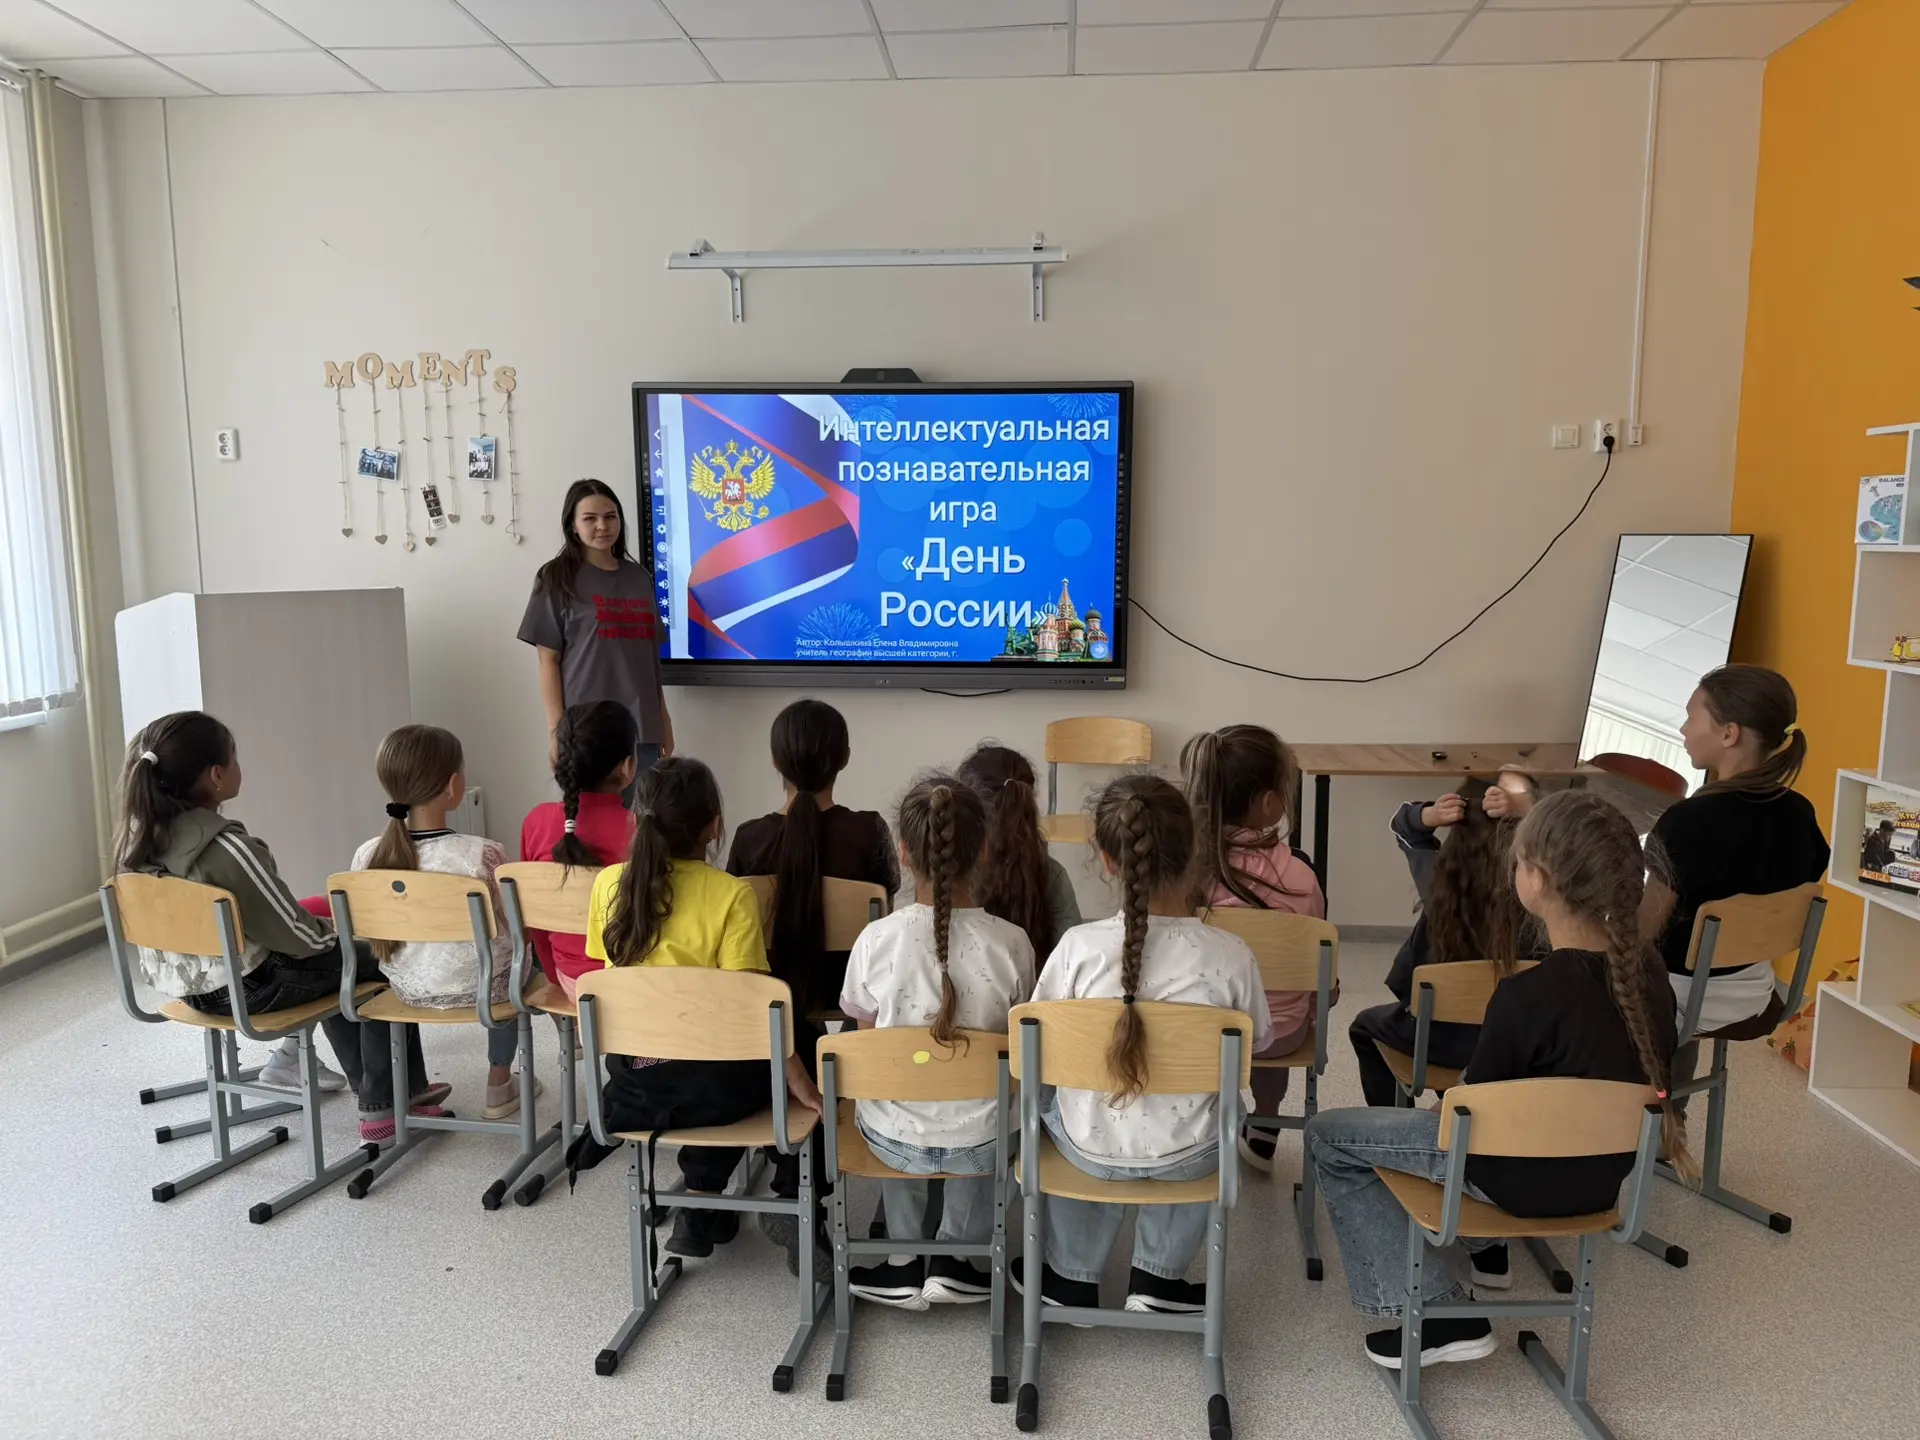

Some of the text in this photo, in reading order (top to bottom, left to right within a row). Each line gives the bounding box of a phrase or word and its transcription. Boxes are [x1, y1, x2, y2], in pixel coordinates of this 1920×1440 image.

[323, 349, 517, 393] MOMENTS
[818, 413, 1110, 448] Интеллектуальная
[838, 460, 1090, 482] познавательная
[929, 501, 998, 528] игра
[901, 537, 1026, 581] «День
[880, 591, 1048, 628] России»
[830, 649, 872, 658] географии
[873, 649, 906, 657] высшей
[873, 639, 897, 647] Елена
[899, 639, 959, 648] Владимировна
